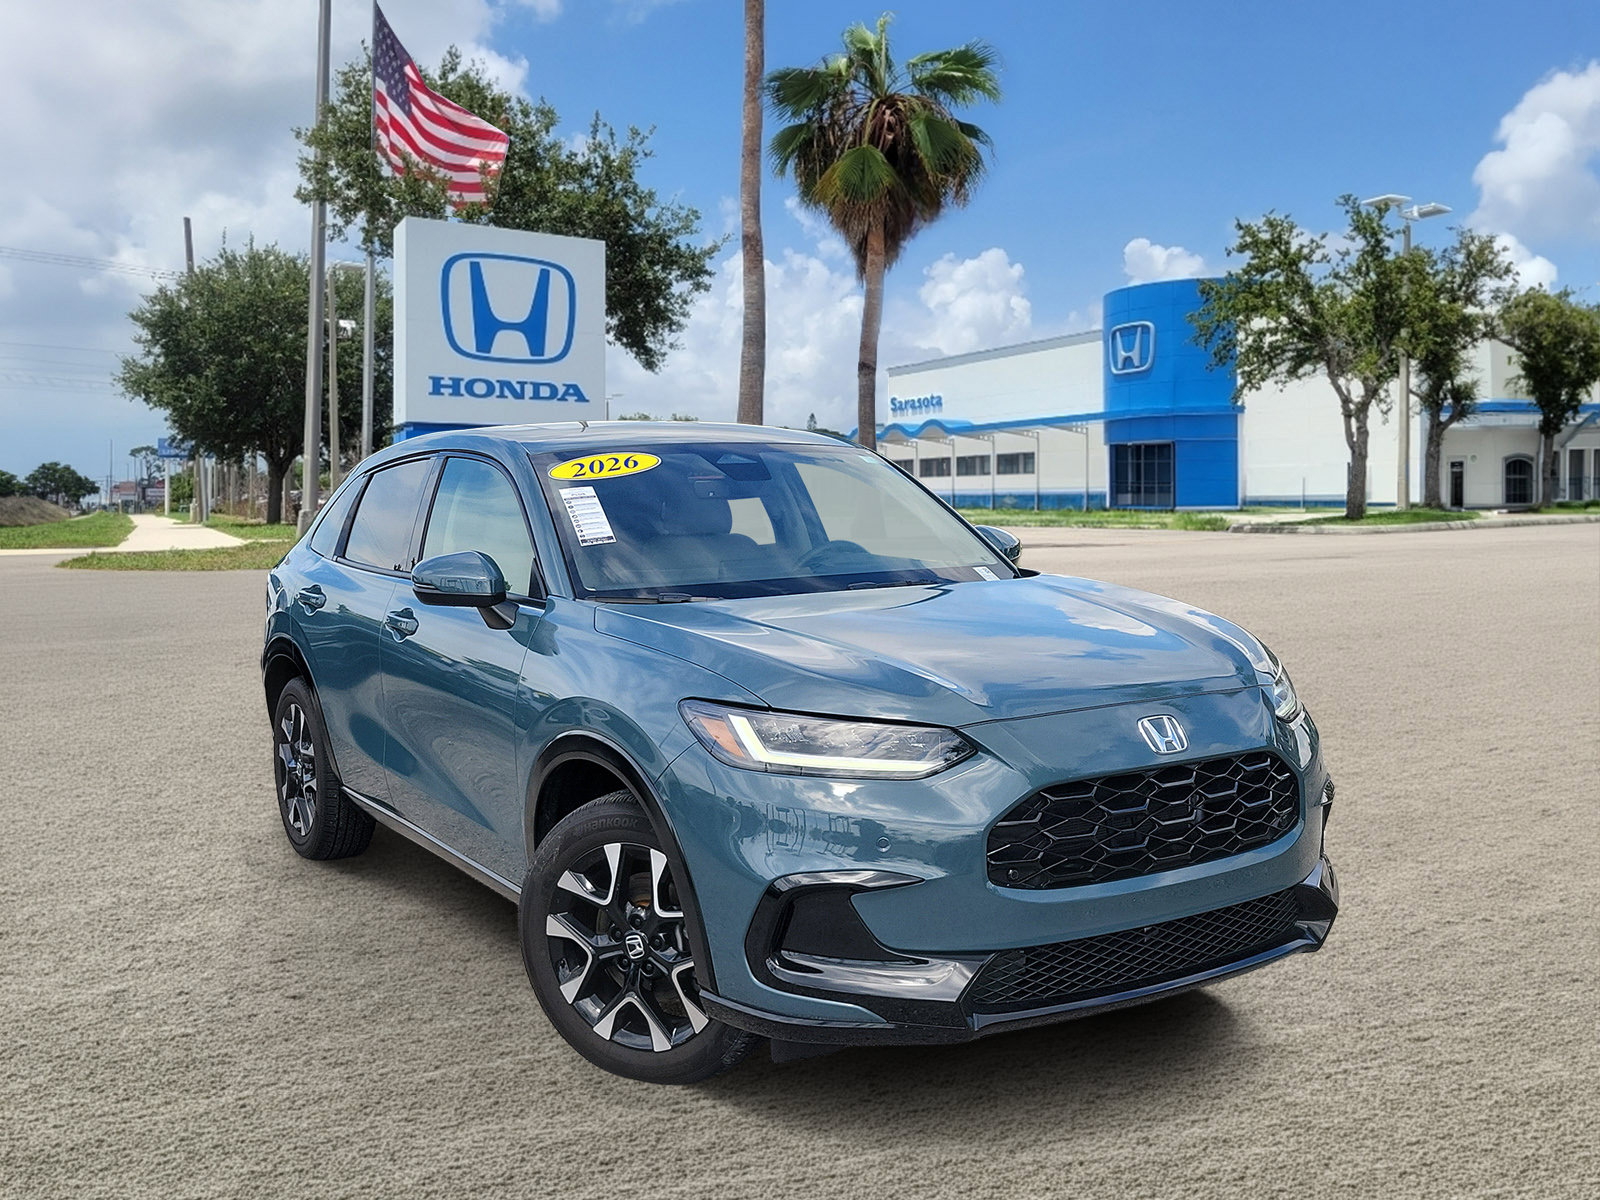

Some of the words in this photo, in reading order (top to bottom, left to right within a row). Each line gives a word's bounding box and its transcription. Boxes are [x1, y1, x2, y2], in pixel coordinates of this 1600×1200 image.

[428, 376, 589, 403] HONDA
[890, 393, 943, 411] Sarasota
[570, 455, 639, 478] 2026
